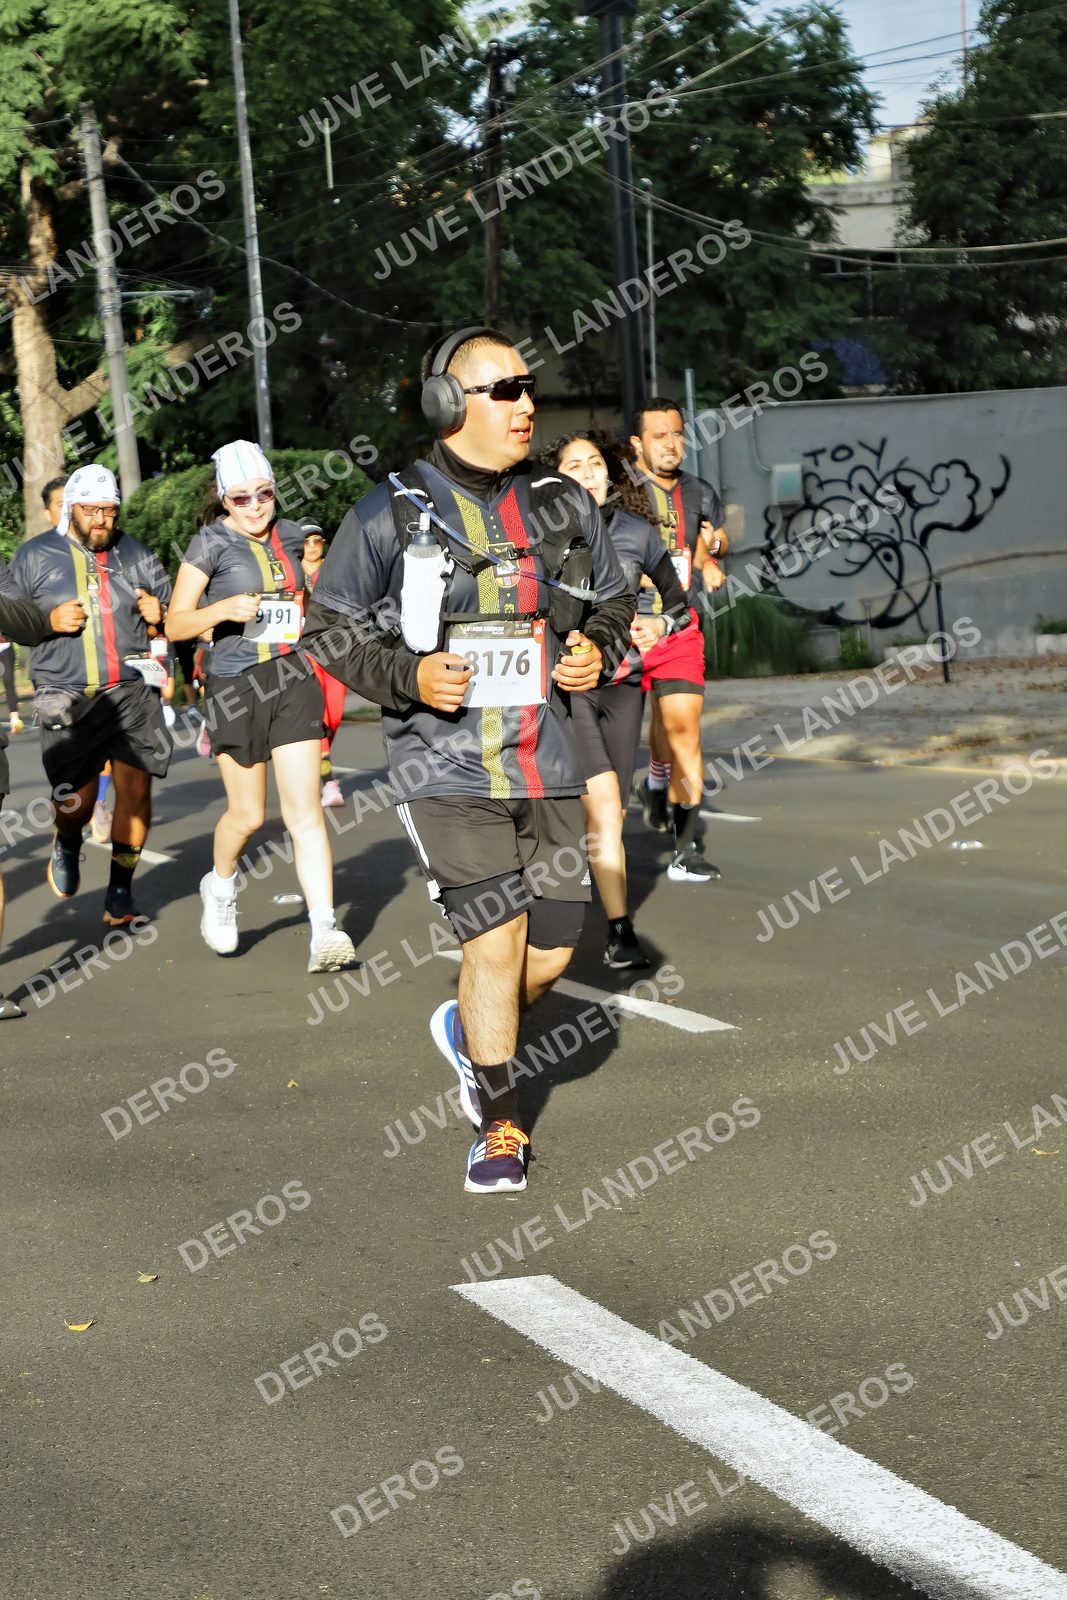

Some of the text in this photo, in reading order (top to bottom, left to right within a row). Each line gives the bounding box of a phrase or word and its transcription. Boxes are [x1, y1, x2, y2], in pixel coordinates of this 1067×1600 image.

[803, 437, 887, 470] TOY
[256, 608, 291, 624] 9191
[464, 649, 530, 677] 8176
